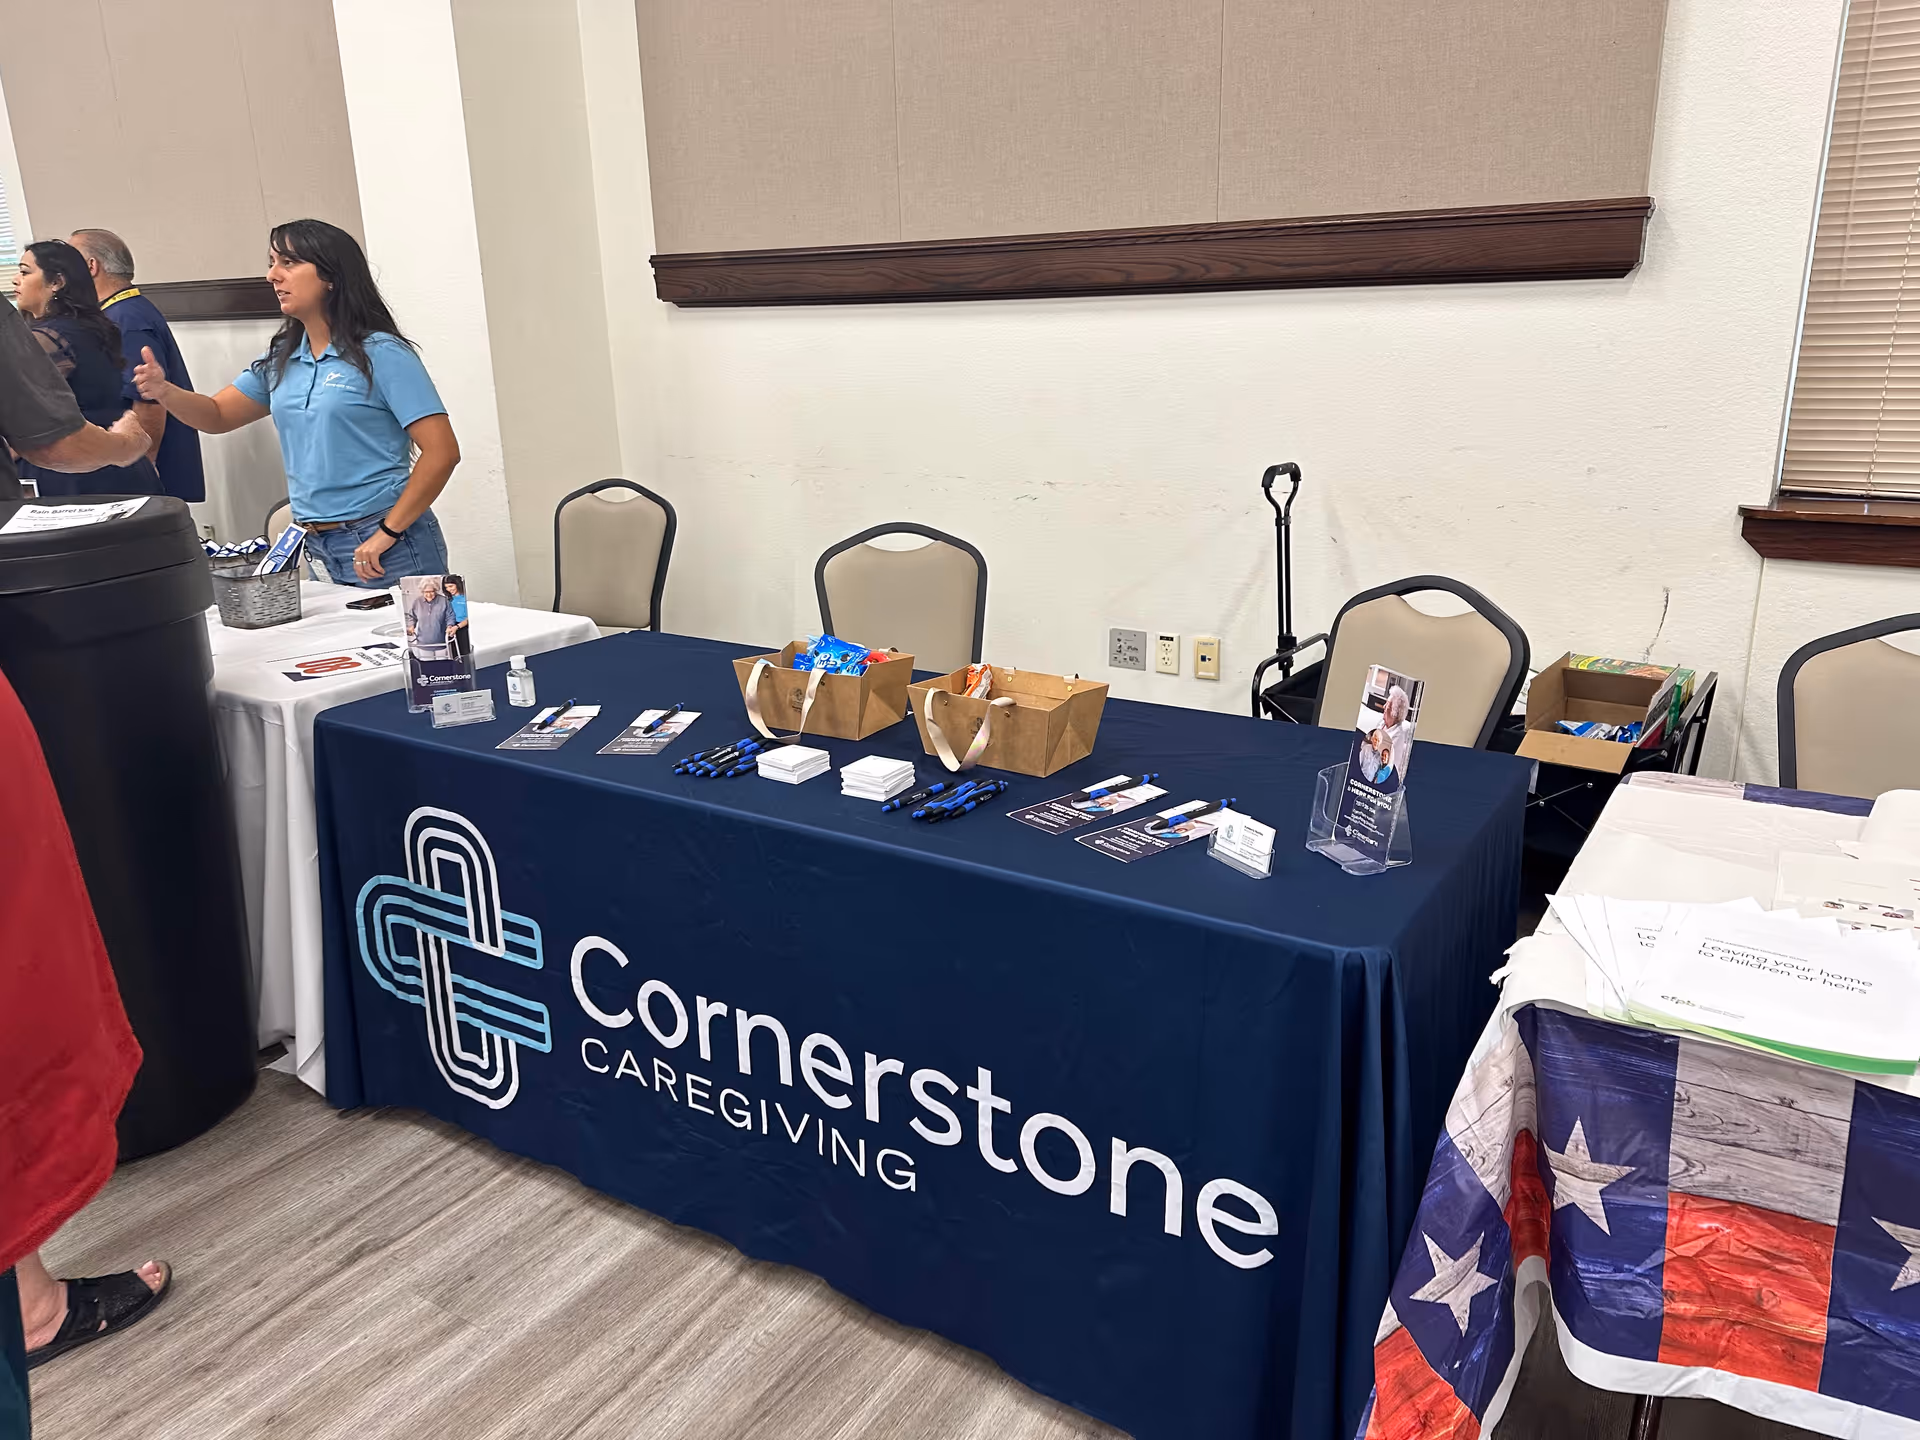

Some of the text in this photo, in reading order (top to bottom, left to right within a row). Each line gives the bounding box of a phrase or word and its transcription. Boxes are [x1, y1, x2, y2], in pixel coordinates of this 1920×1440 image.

[429, 674, 471, 682] Cornerstone
[1698, 949, 1714, 958] to
[1719, 955, 1791, 977] children
[1797, 974, 1816, 982] or
[1822, 978, 1867, 995] heirs
[1702, 942, 1768, 964] Leaving
[1774, 959, 1815, 973] your
[1820, 968, 1873, 987] home
[1660, 995, 1696, 1007] cfpb
[569, 935, 1279, 1270] Cornerstone
[580, 1037, 918, 1193] CAREGIVING
